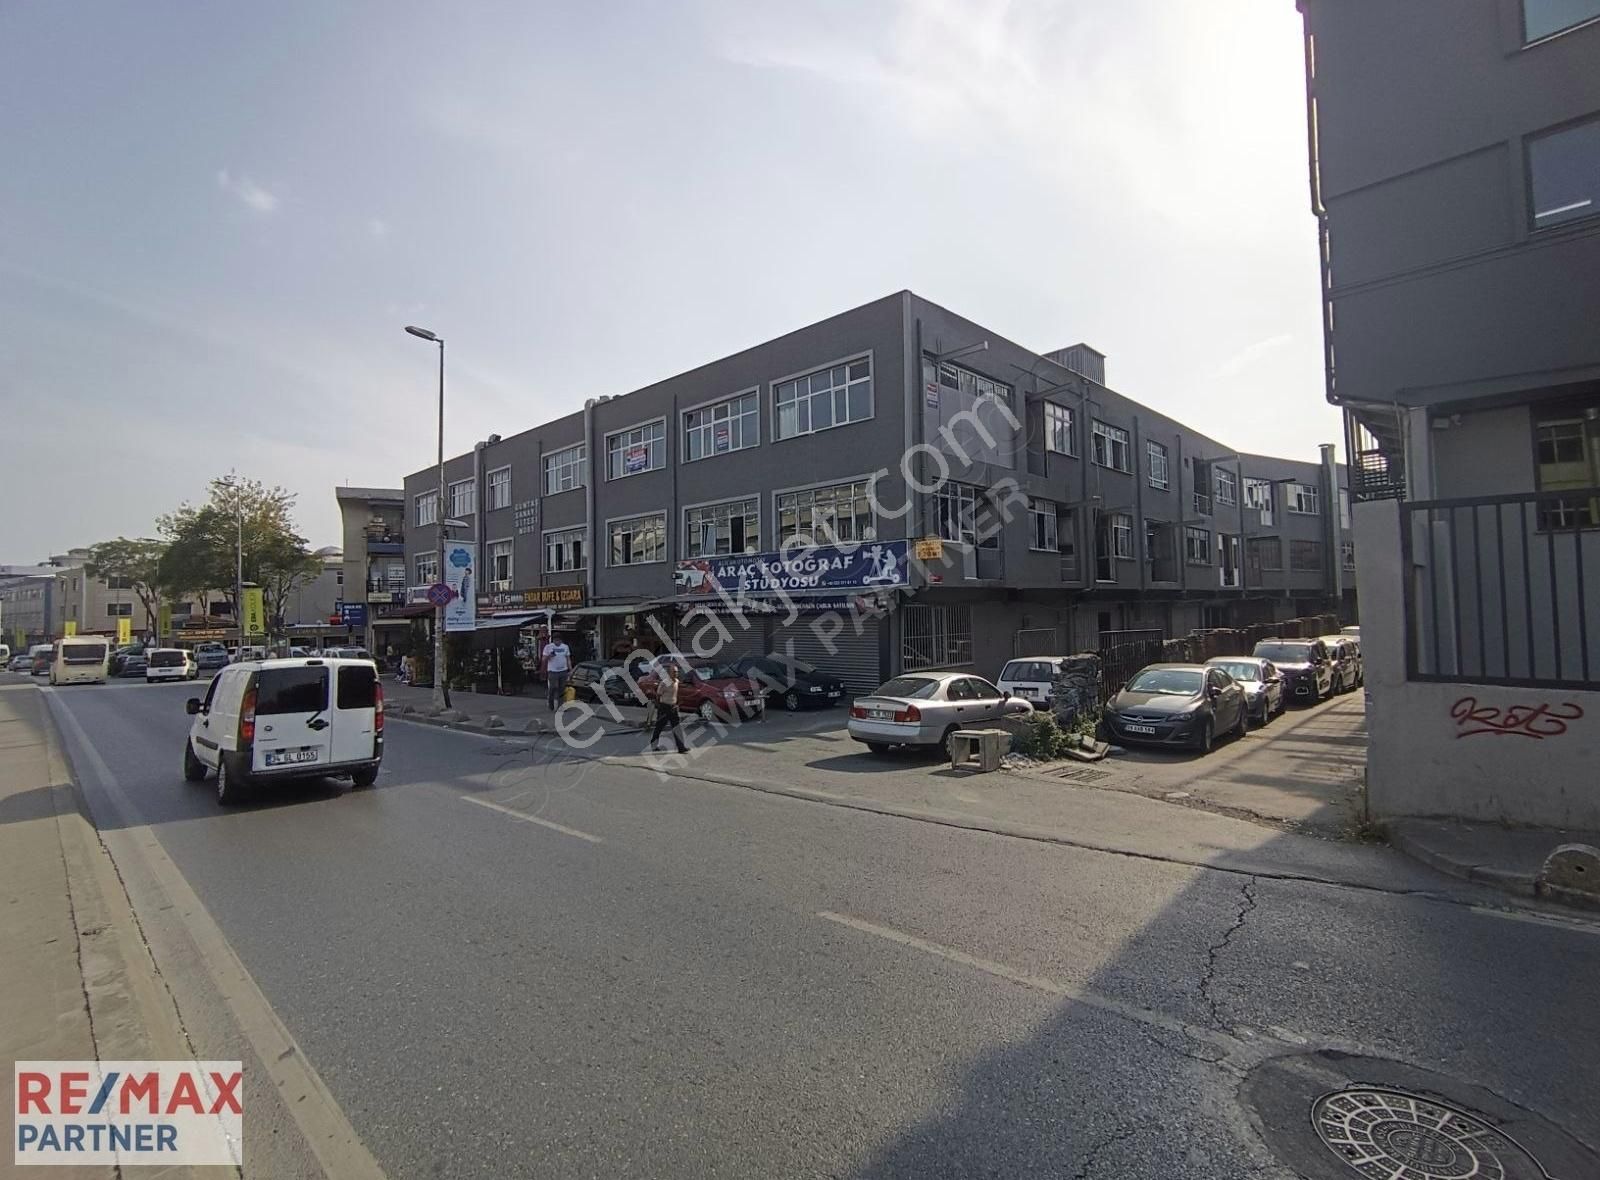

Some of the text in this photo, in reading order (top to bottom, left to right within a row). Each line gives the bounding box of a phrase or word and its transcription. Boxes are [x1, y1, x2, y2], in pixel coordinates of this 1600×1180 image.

[717, 554, 854, 579] ARAÇ FOTOĞRAF
[744, 575, 820, 590] STÜDYOSU
